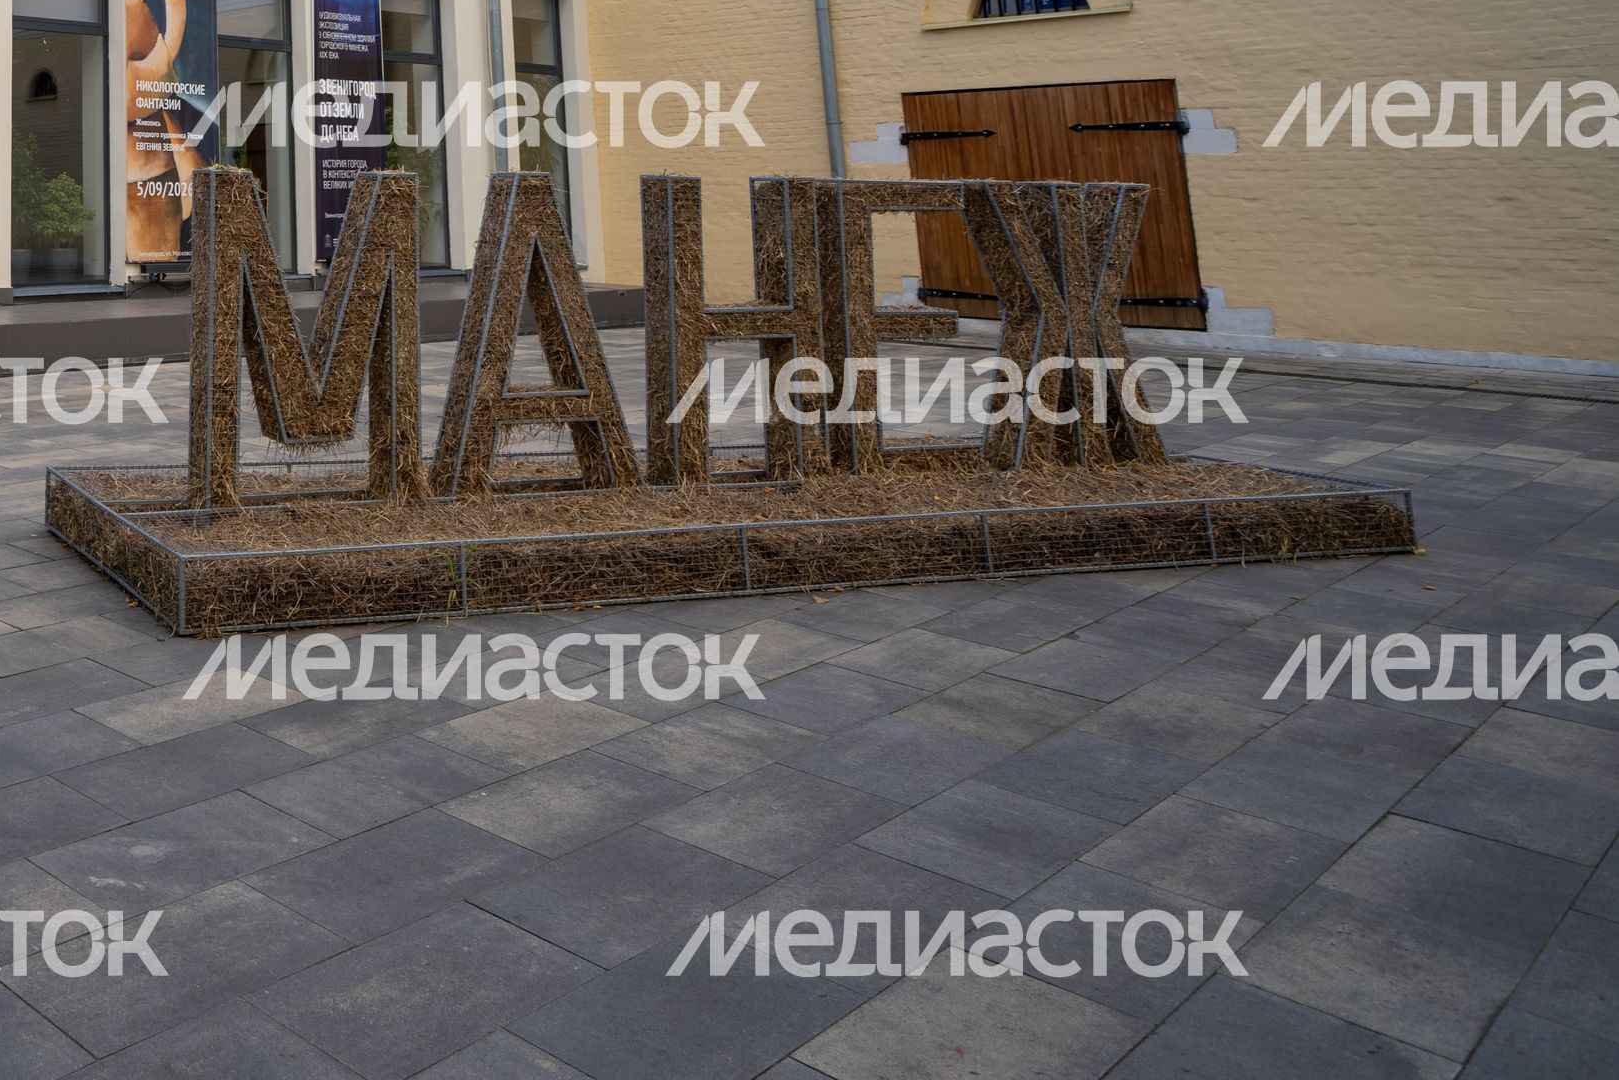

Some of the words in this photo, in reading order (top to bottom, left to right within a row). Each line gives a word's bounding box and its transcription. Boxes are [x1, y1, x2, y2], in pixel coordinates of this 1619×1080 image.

[135, 80, 206, 96] НИКОЛОГОРСКИЕ
[319, 78, 377, 100] ЗВЕНИГОРОД
[135, 97, 181, 110] ФАНТАЗИИ
[319, 101, 332, 117] ОТ
[332, 102, 364, 119] ЗЕМЛИ
[336, 125, 359, 142] НЕБА
[135, 142, 161, 151] ЕВГЕНИЯ
[189, 167, 1167, 510] МАНЕЖ
